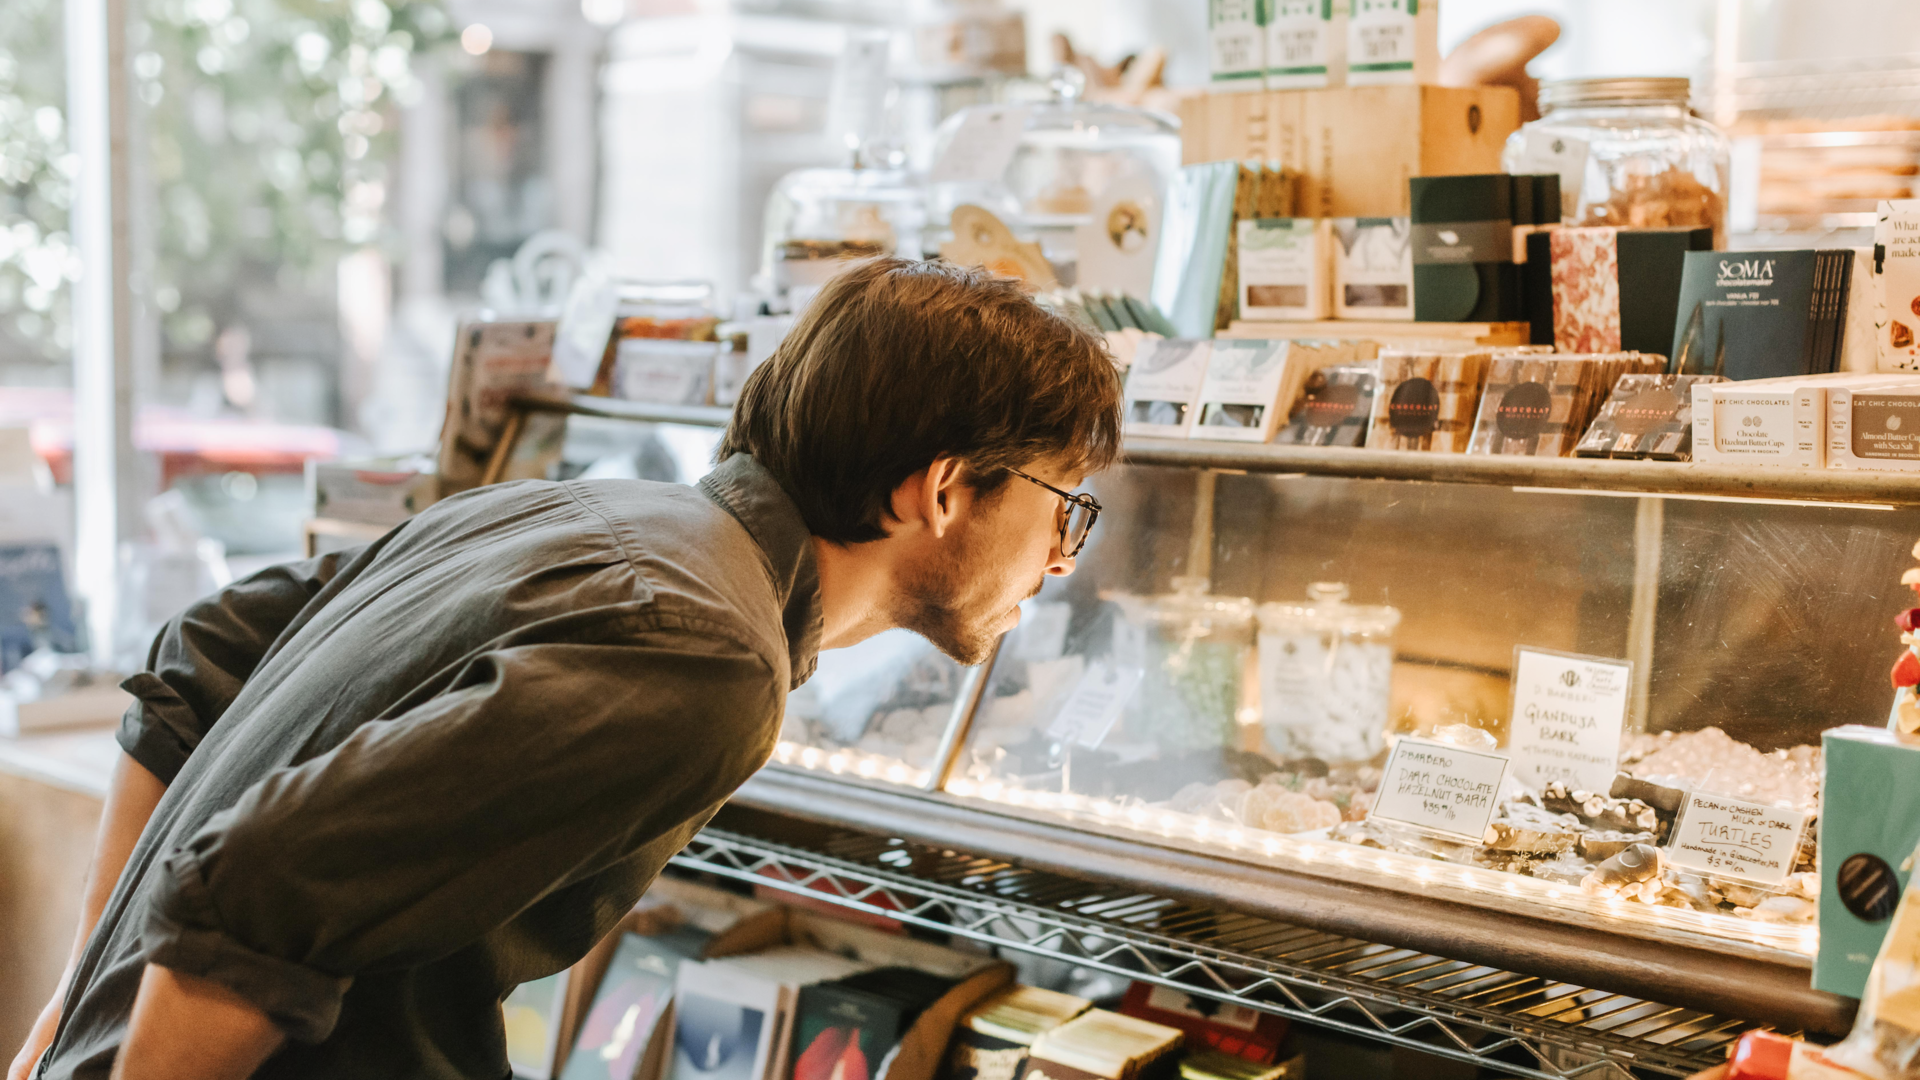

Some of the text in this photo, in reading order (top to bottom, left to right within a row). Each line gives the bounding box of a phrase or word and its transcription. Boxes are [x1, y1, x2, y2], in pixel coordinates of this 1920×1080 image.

[1894, 221, 1918, 231] What
[1892, 236, 1906, 244] are
[1891, 247, 1916, 258] made
[1498, 406, 1550, 415] CHOCOLAT
[1619, 408, 1674, 416] CHOCOLAT
[1736, 430, 1768, 438] Chocolate
[1861, 432, 1887, 440] Almond
[1887, 432, 1908, 441] Butter
[1721, 438, 1785, 448] Hazelnut Butter Cups
[1873, 441, 1913, 450] with Sea Salt
[1524, 702, 1597, 729] GIANDUJA
[1540, 726, 1579, 745] BARK
[1400, 768, 1494, 795] DARK CHOCOLATE
[1397, 782, 1488, 808] HAZELNUT BARK
[1693, 798, 1719, 810] PECAN
[1731, 814, 1755, 825] MILK
[1768, 819, 1792, 831] DARK
[1698, 821, 1772, 850] TURTLES
[1681, 842, 1717, 855] Handmade
[1720, 849, 1727, 857] in
